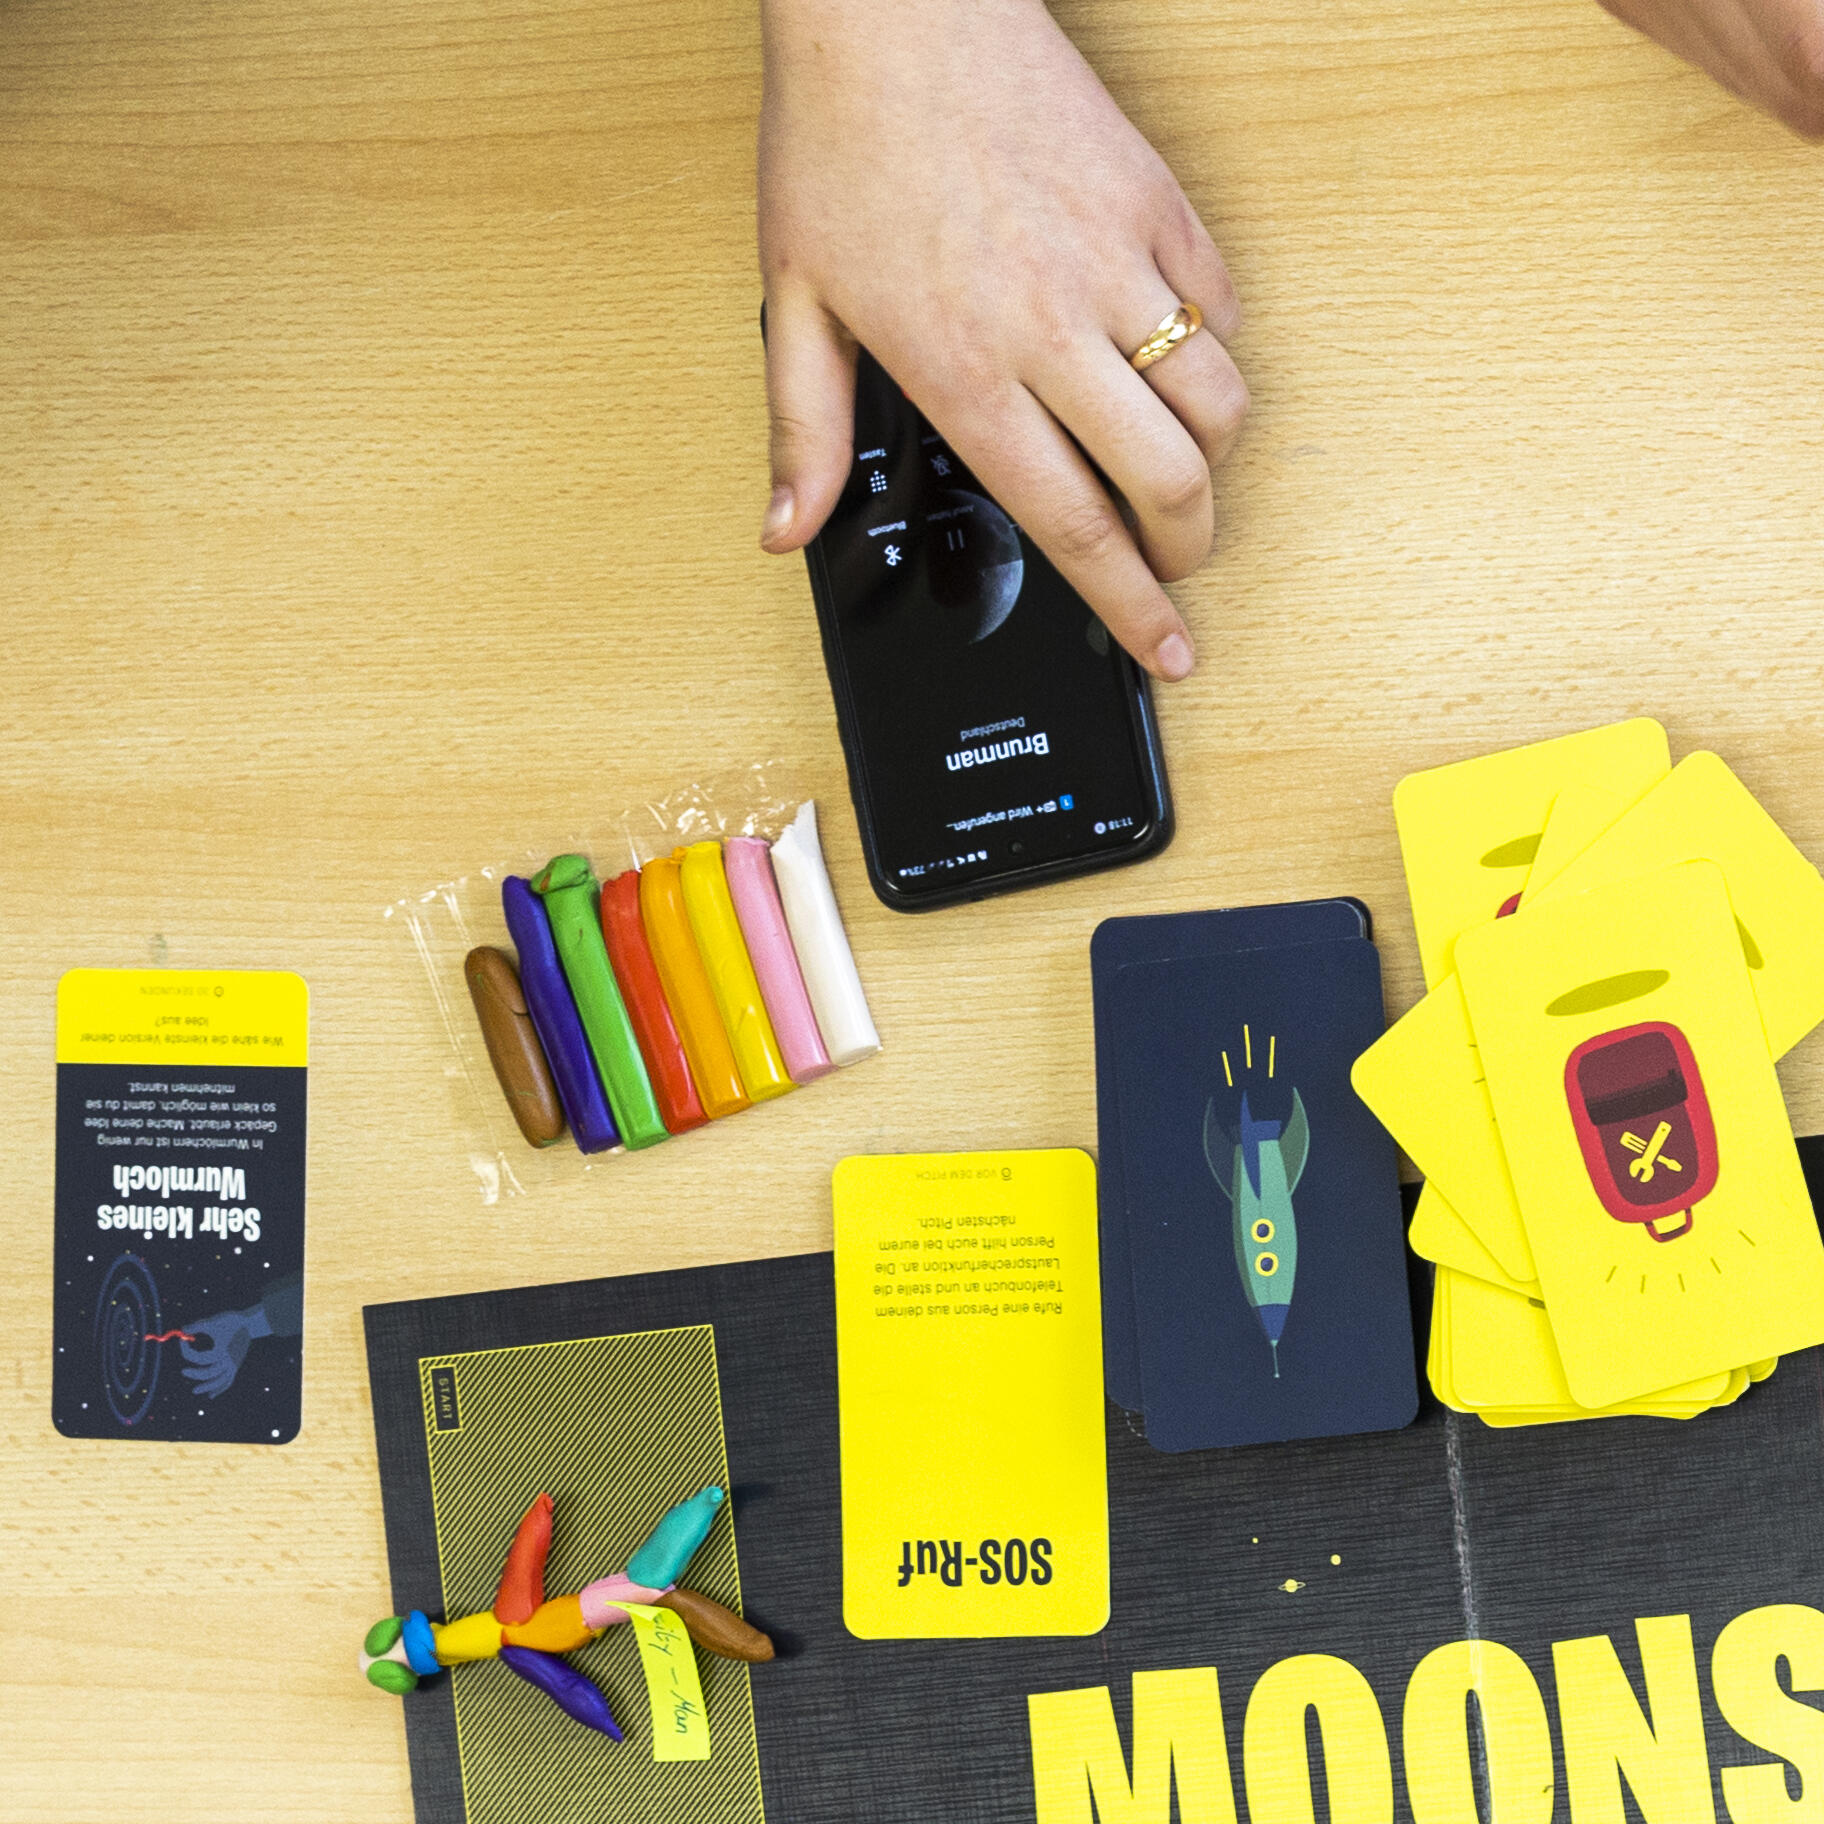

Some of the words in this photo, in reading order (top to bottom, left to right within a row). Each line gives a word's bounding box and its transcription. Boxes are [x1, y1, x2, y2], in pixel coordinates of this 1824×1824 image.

[960, 716, 1025, 742] Deutschland
[946, 732, 1049, 771] Brunman
[1008, 806, 1033, 820] Wird
[85, 1118, 109, 1128] Idee
[112, 1118, 143, 1128] deine
[147, 1119, 184, 1130] Mache
[235, 1120, 277, 1133] Gepäck
[98, 1134, 131, 1145] wenig
[135, 1137, 153, 1146] nur
[156, 1138, 170, 1147] ist
[253, 1140, 263, 1149] In
[113, 1165, 246, 1201] Wurmloch
[97, 1205, 193, 1240] kleines
[199, 1207, 261, 1242] Sehr
[956, 1215, 1016, 1228] nächsten
[873, 1284, 893, 1296] die
[897, 1283, 932, 1296] stelle
[935, 1283, 960, 1295] und
[964, 1282, 980, 1293] an
[984, 1279, 1064, 1294] Telefonbuch
[875, 1306, 923, 1317] deinem
[927, 1305, 950, 1316] aus
[954, 1304, 998, 1317] Person
[1002, 1302, 1030, 1313] eine
[1033, 1302, 1063, 1315] Rufe
[438, 1377, 453, 1419] START
[898, 1538, 1053, 1587] SOS-Ruf
